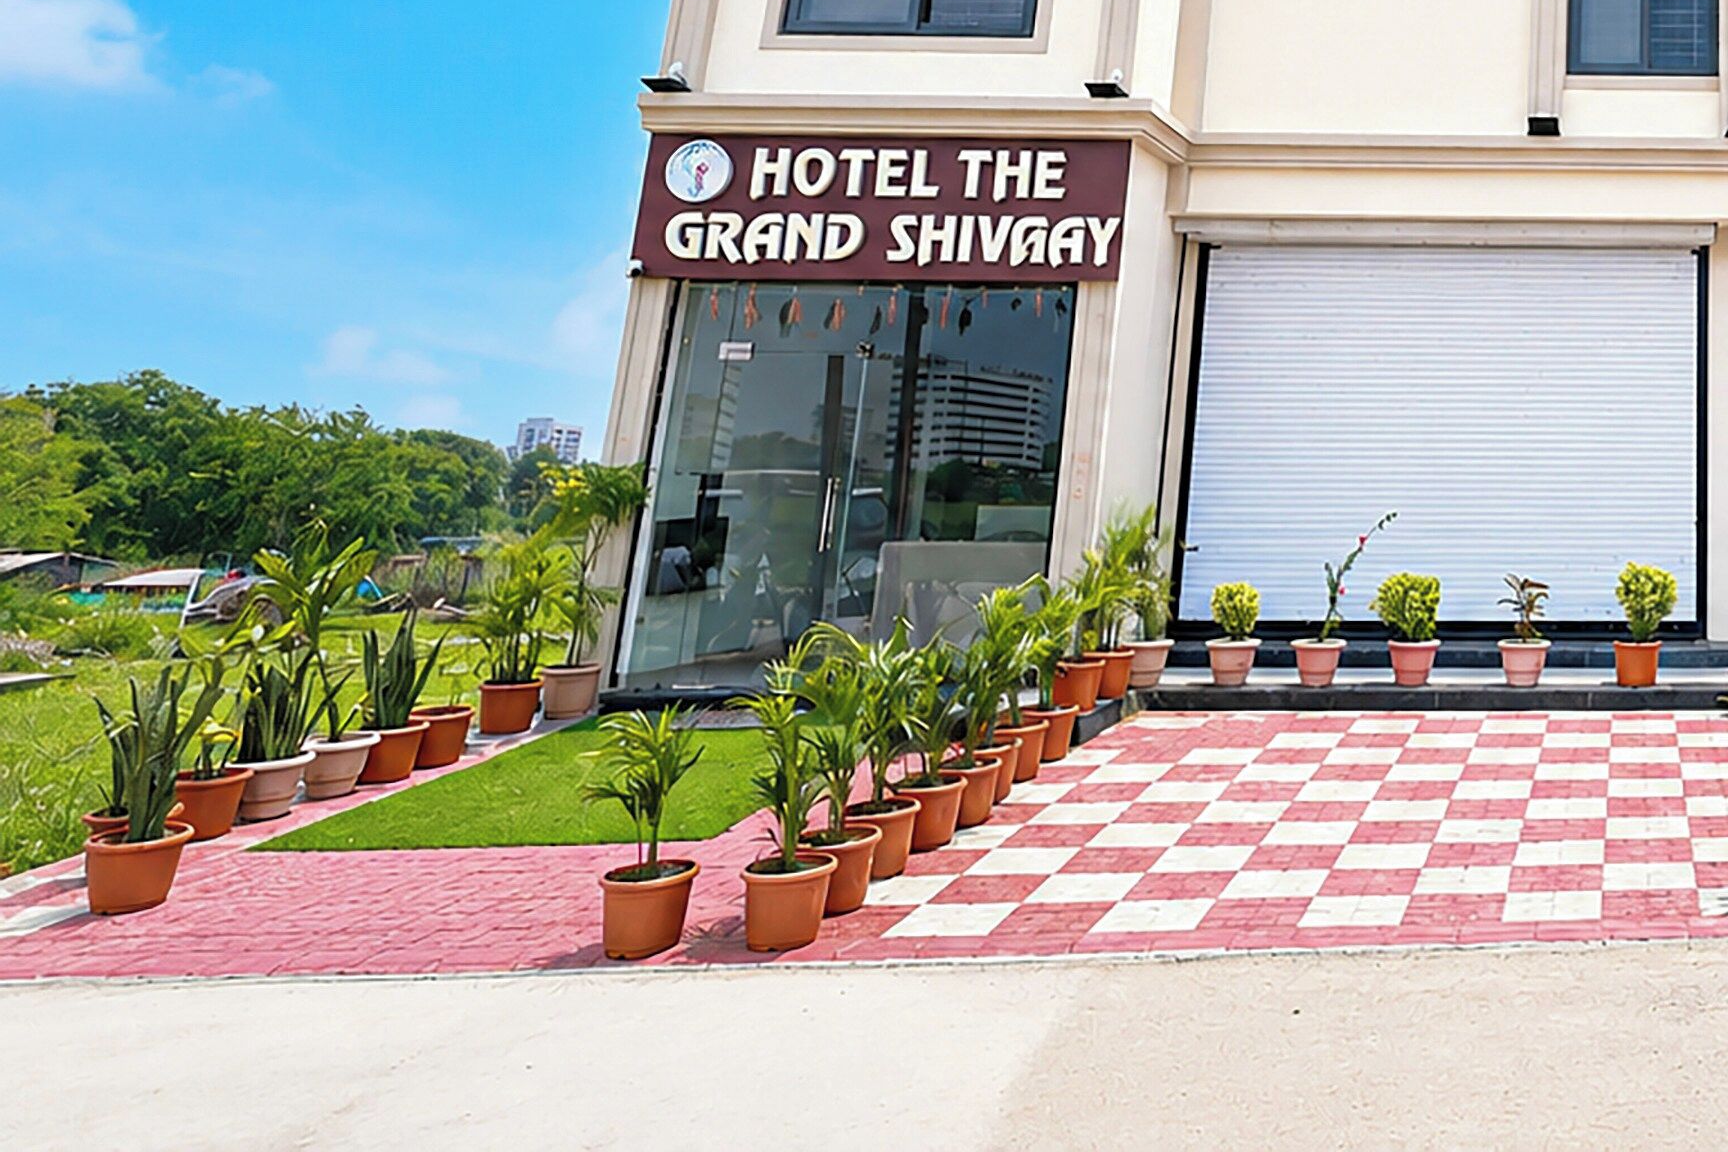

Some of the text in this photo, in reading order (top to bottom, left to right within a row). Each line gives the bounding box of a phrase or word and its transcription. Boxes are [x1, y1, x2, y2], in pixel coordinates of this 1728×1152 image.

[750, 148, 1066, 202] HOTEL THE
[664, 211, 865, 264] GRAND
